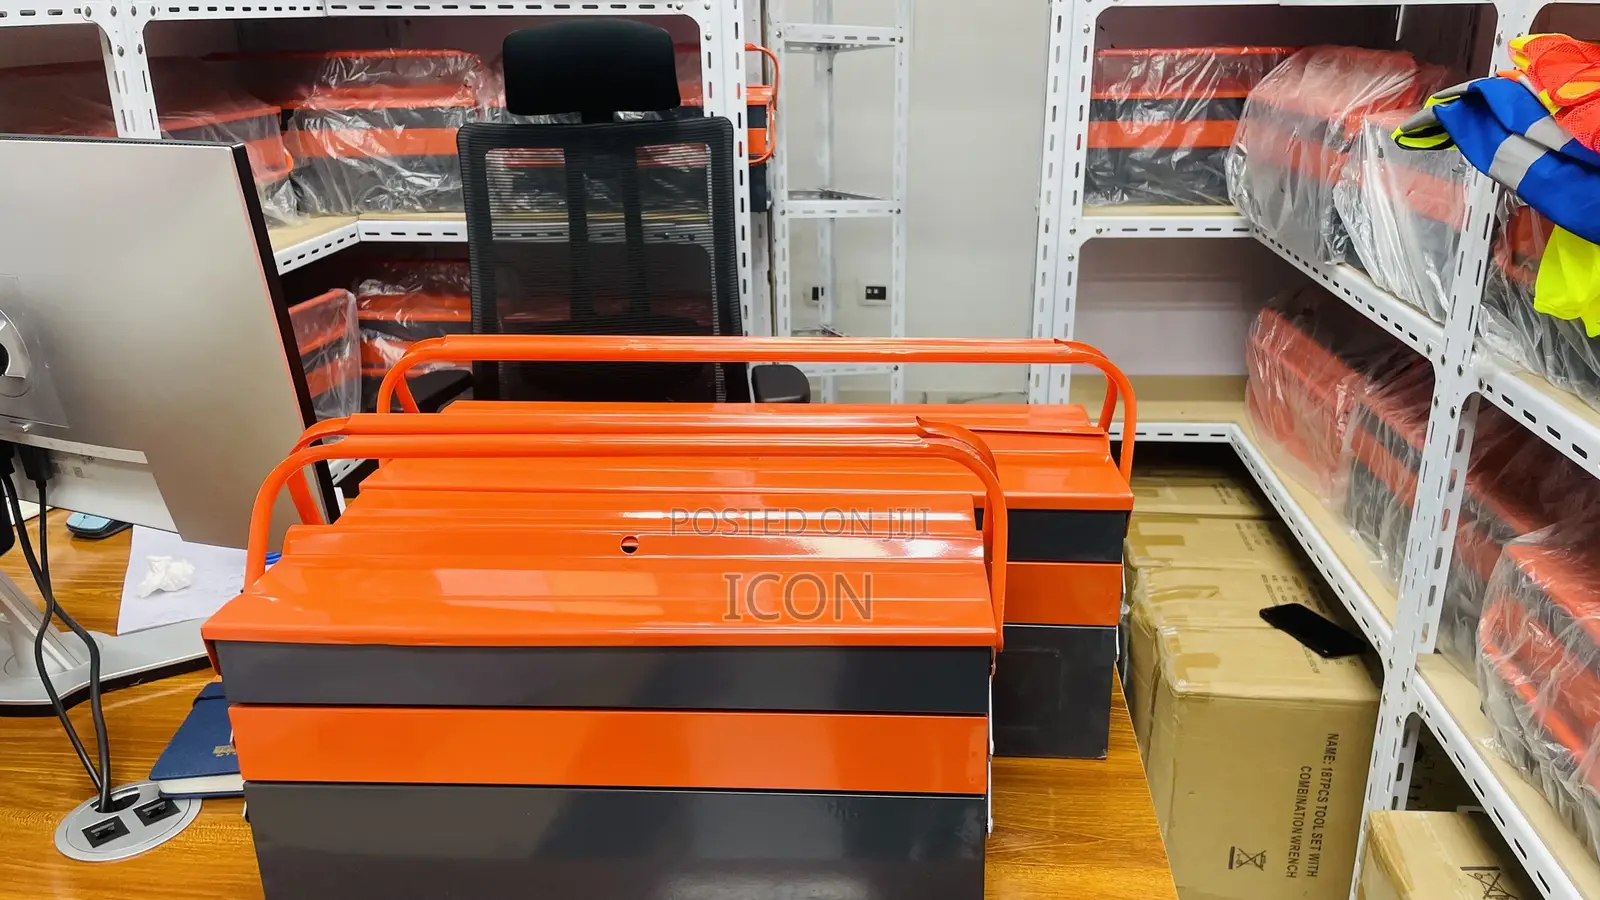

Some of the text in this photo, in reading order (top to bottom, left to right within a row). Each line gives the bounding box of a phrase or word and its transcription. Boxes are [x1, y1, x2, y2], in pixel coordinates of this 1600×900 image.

[1285, 765, 1312, 878] COMBINATION WRENCH
[1306, 733, 1339, 878] NAME: 187PCS TOOL SET WITH
